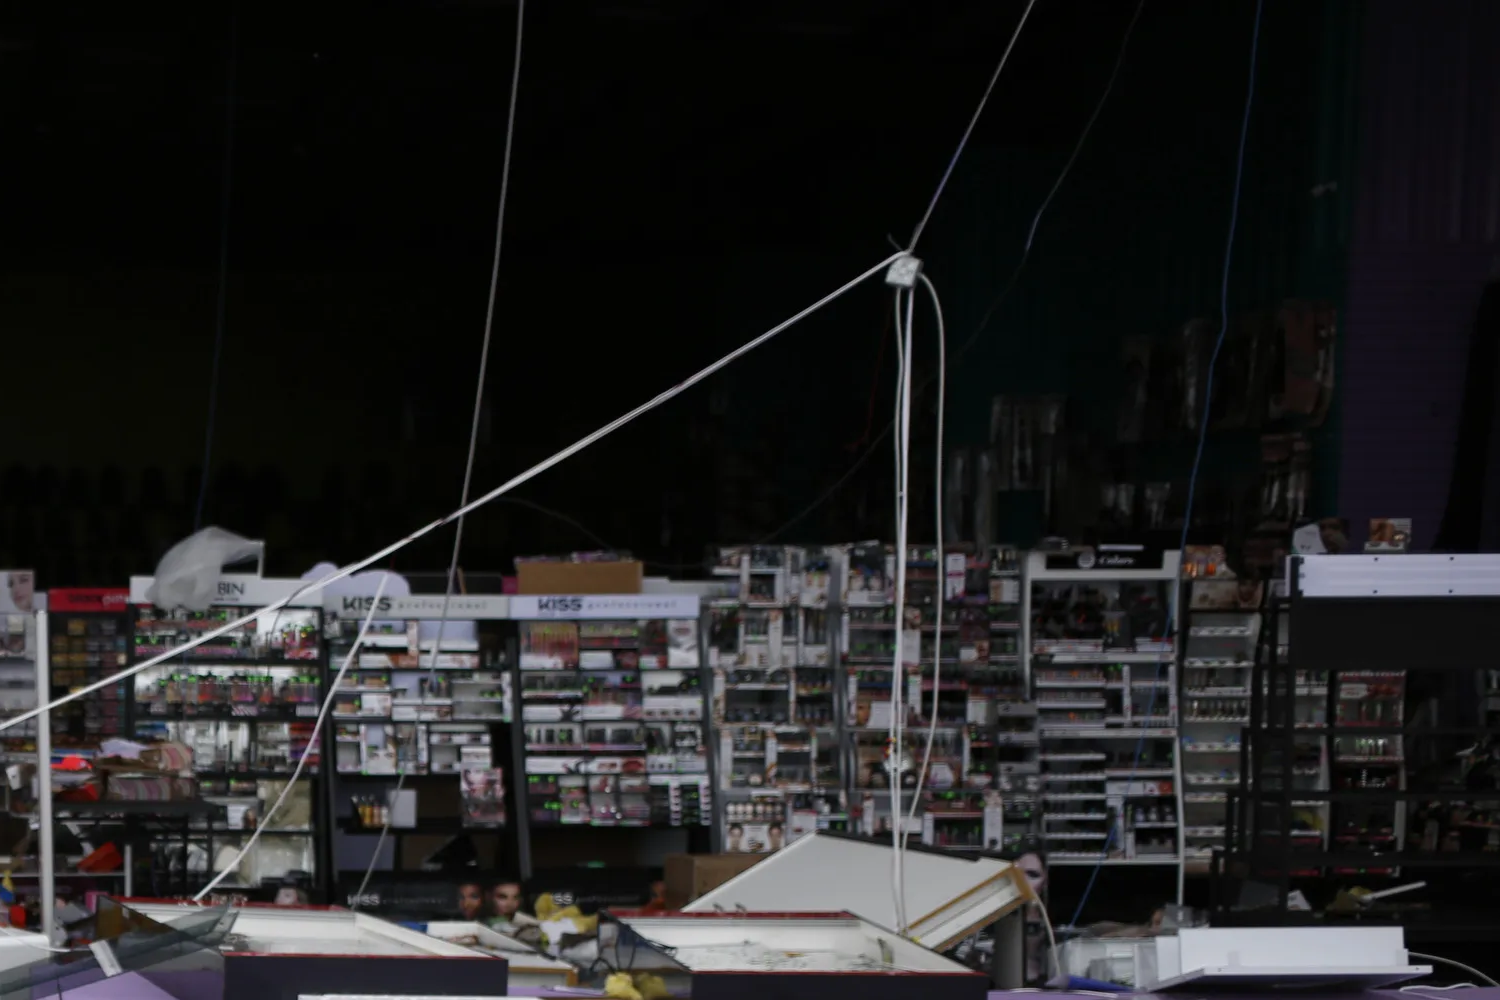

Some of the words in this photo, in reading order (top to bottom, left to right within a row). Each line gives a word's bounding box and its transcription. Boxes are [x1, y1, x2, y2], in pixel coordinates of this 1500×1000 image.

[343, 597, 392, 611] KISS
[397, 599, 488, 611] profesional
[538, 598, 582, 611] KISS
[552, 891, 573, 905] SS
